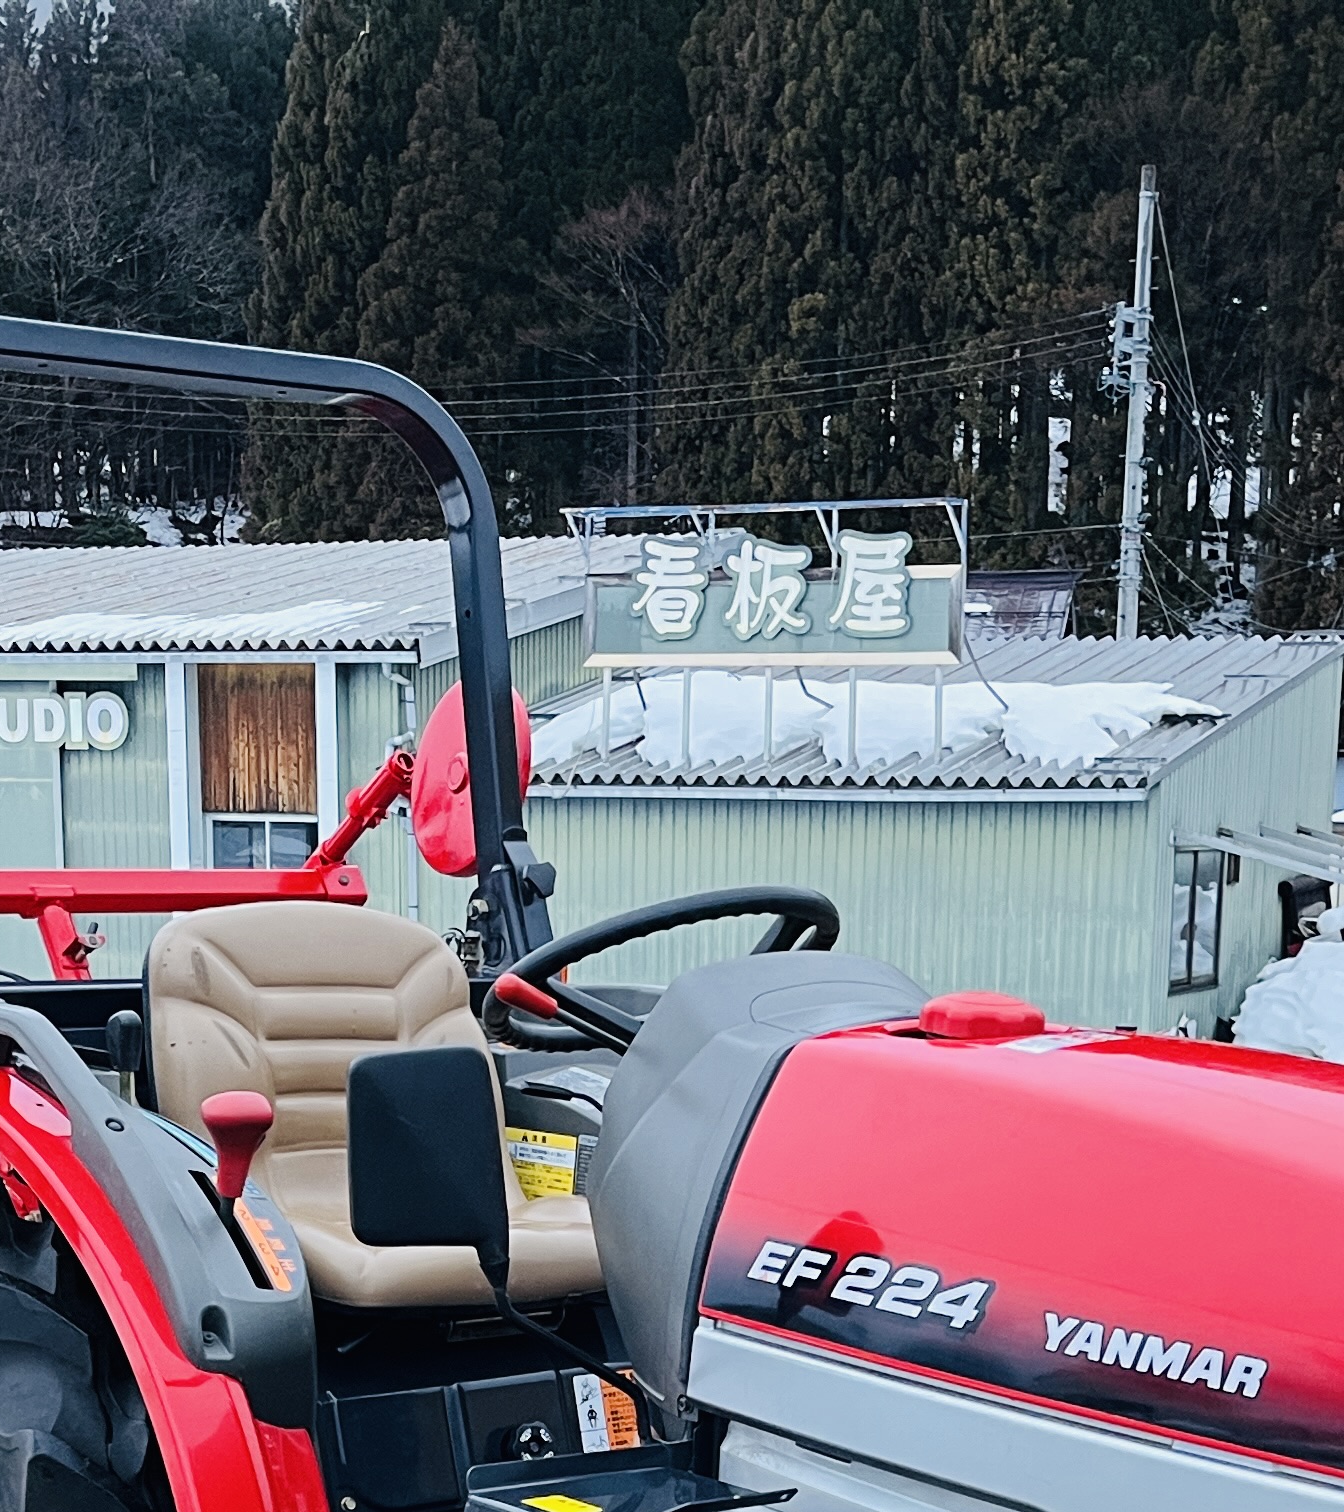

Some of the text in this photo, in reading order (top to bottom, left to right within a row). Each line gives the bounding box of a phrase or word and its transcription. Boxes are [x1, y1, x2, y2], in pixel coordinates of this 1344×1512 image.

[631, 533, 909, 636] 看板屋
[747, 1240, 998, 1330] EF 224
[1043, 1311, 1269, 1399] YANMAR
